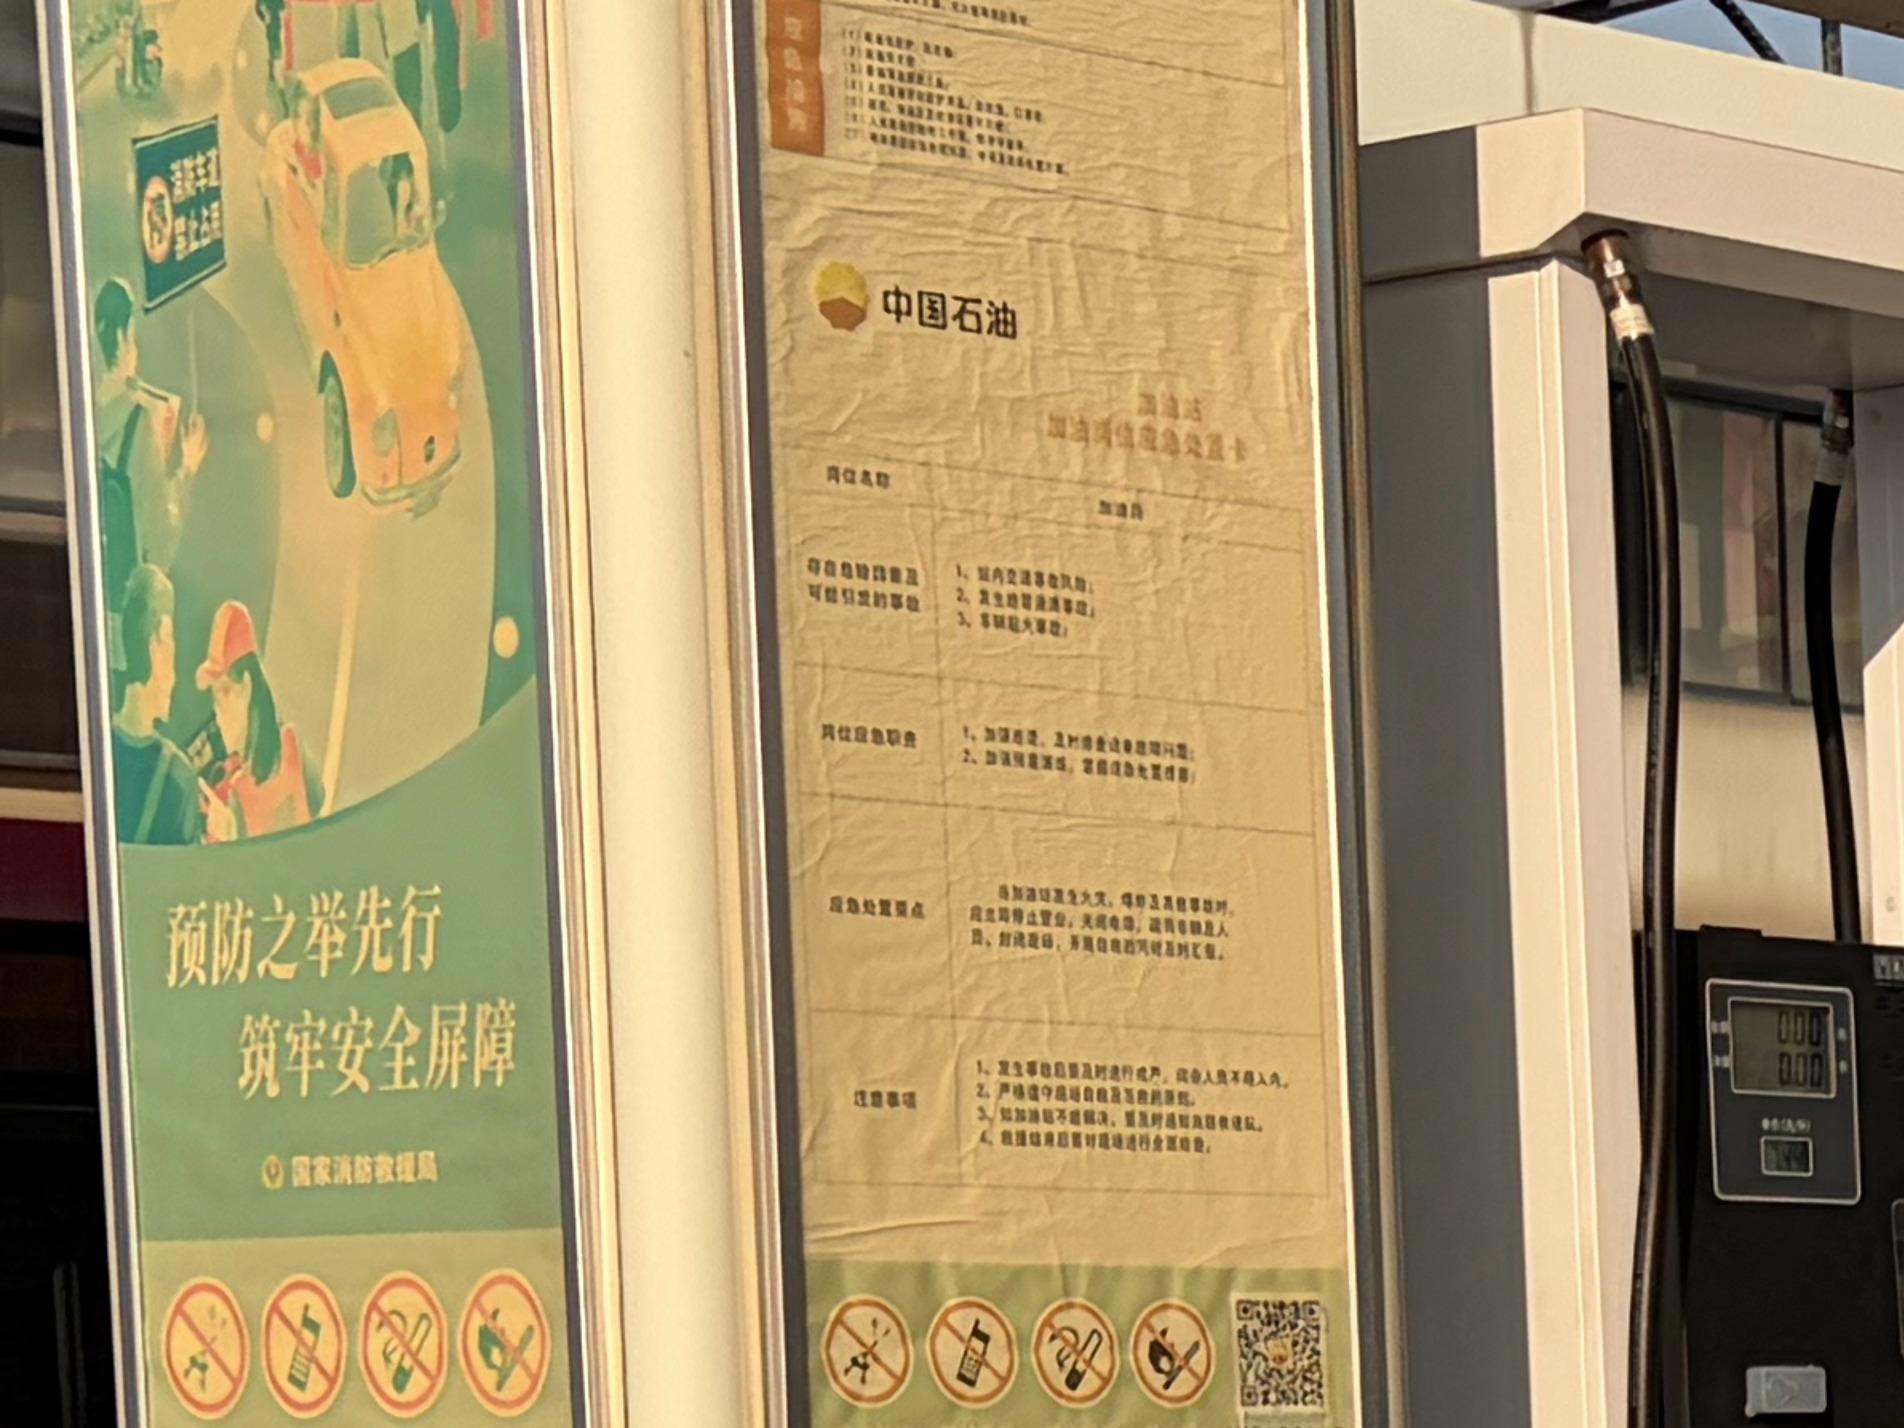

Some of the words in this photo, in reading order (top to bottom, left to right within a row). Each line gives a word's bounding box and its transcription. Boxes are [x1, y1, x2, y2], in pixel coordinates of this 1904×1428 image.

[881, 284, 1018, 340] 中国石油
[166, 883, 443, 989] 预防之举先行
[238, 998, 517, 1103] 筑牢安全屏障
[291, 1150, 438, 1187] 国家消防救援局
